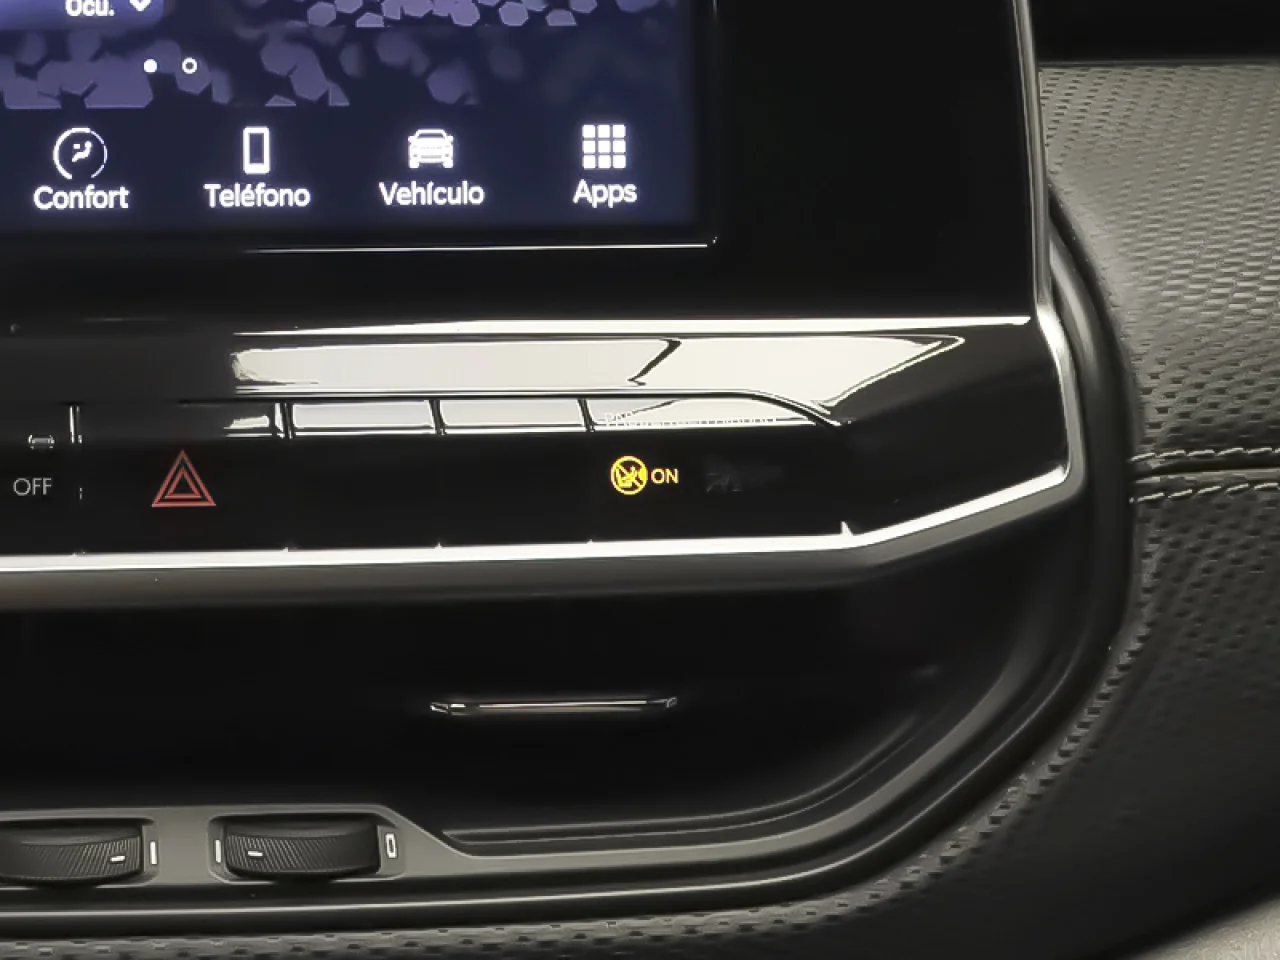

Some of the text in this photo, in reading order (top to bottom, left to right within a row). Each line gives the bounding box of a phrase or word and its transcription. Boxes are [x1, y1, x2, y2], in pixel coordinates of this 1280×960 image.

[32, 184, 130, 210] Confort
[203, 182, 312, 209] Teléfono
[378, 180, 486, 206] Vehículo
[572, 178, 638, 208] Apps
[13, 478, 52, 497] OFF
[650, 467, 679, 484] ON
